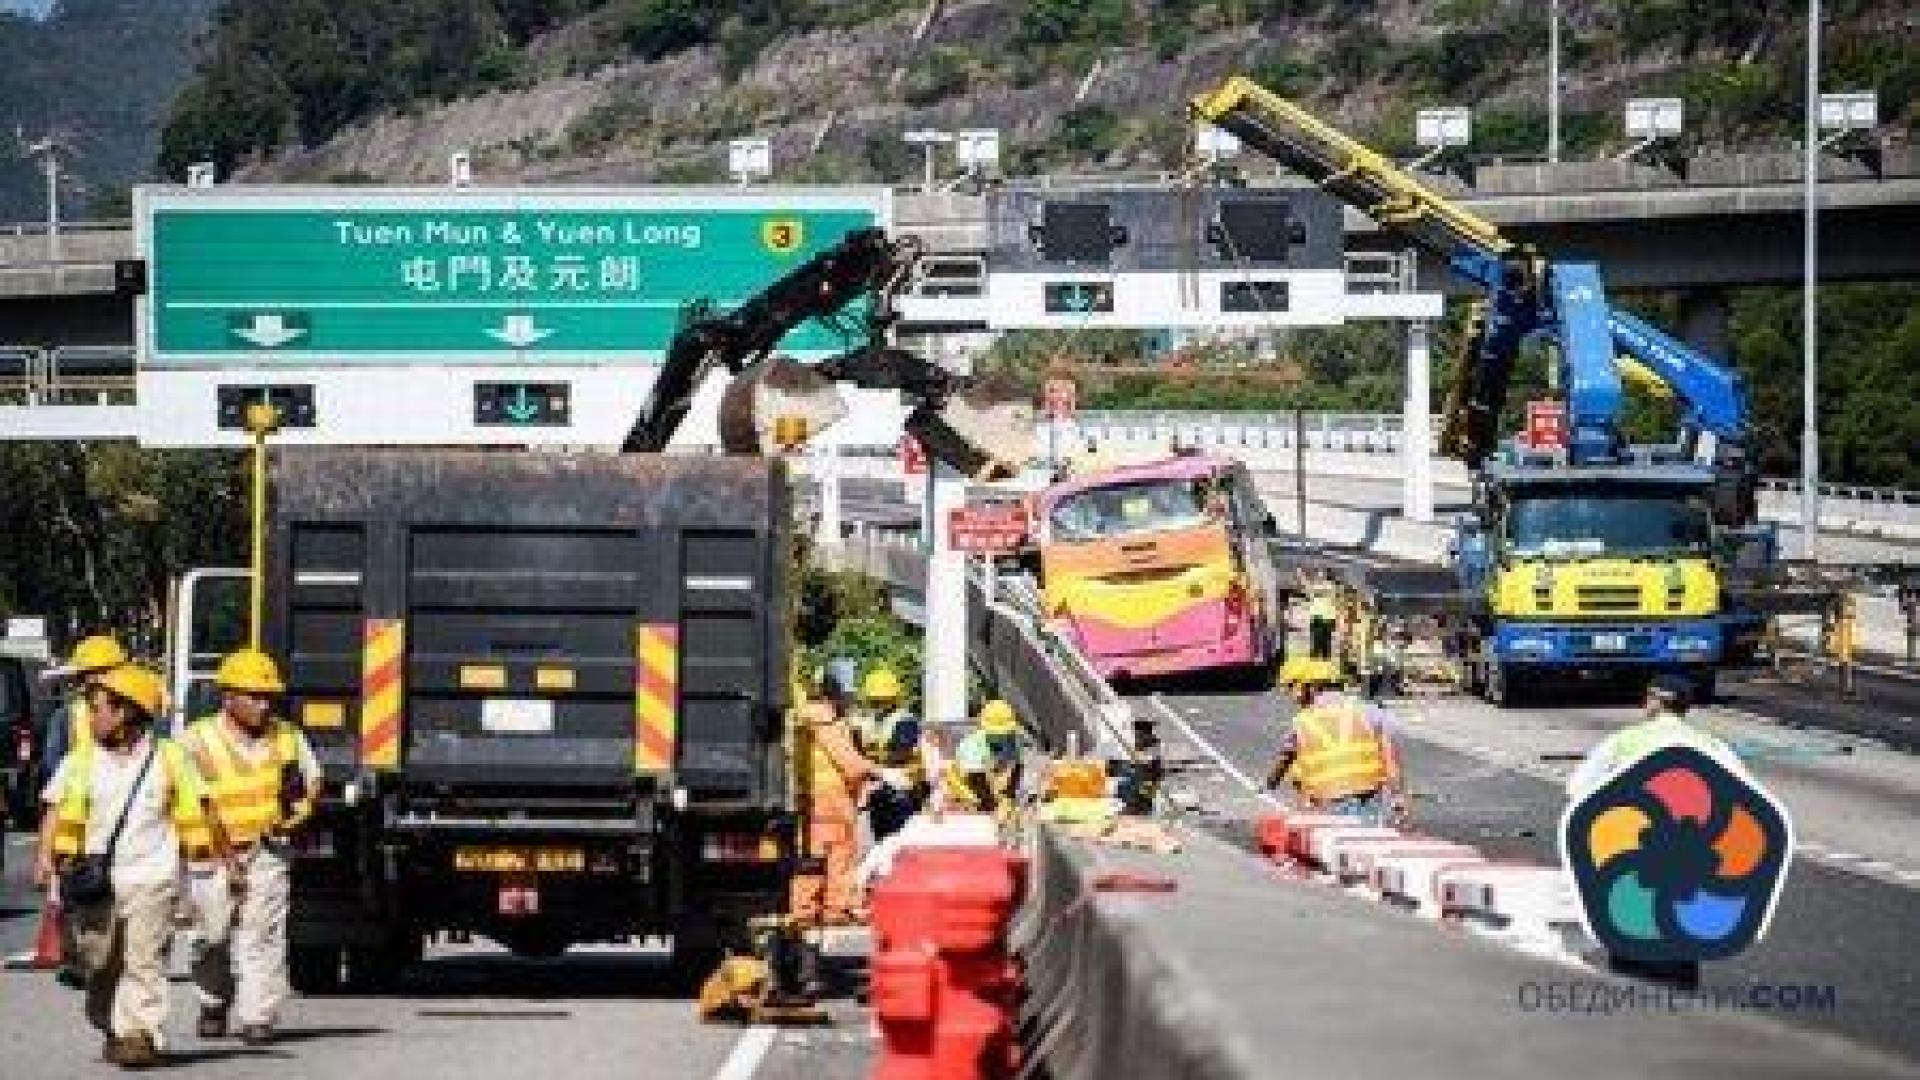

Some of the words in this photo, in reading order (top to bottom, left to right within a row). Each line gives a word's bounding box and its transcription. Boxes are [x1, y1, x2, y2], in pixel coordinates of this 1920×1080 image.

[334, 221, 413, 245] Tuen
[422, 221, 488, 245] Mun
[501, 221, 522, 245] &
[536, 221, 617, 245] Yuen
[626, 221, 702, 250] Long
[771, 225, 791, 249] 3
[403, 256, 638, 291] 屯門及元朗
